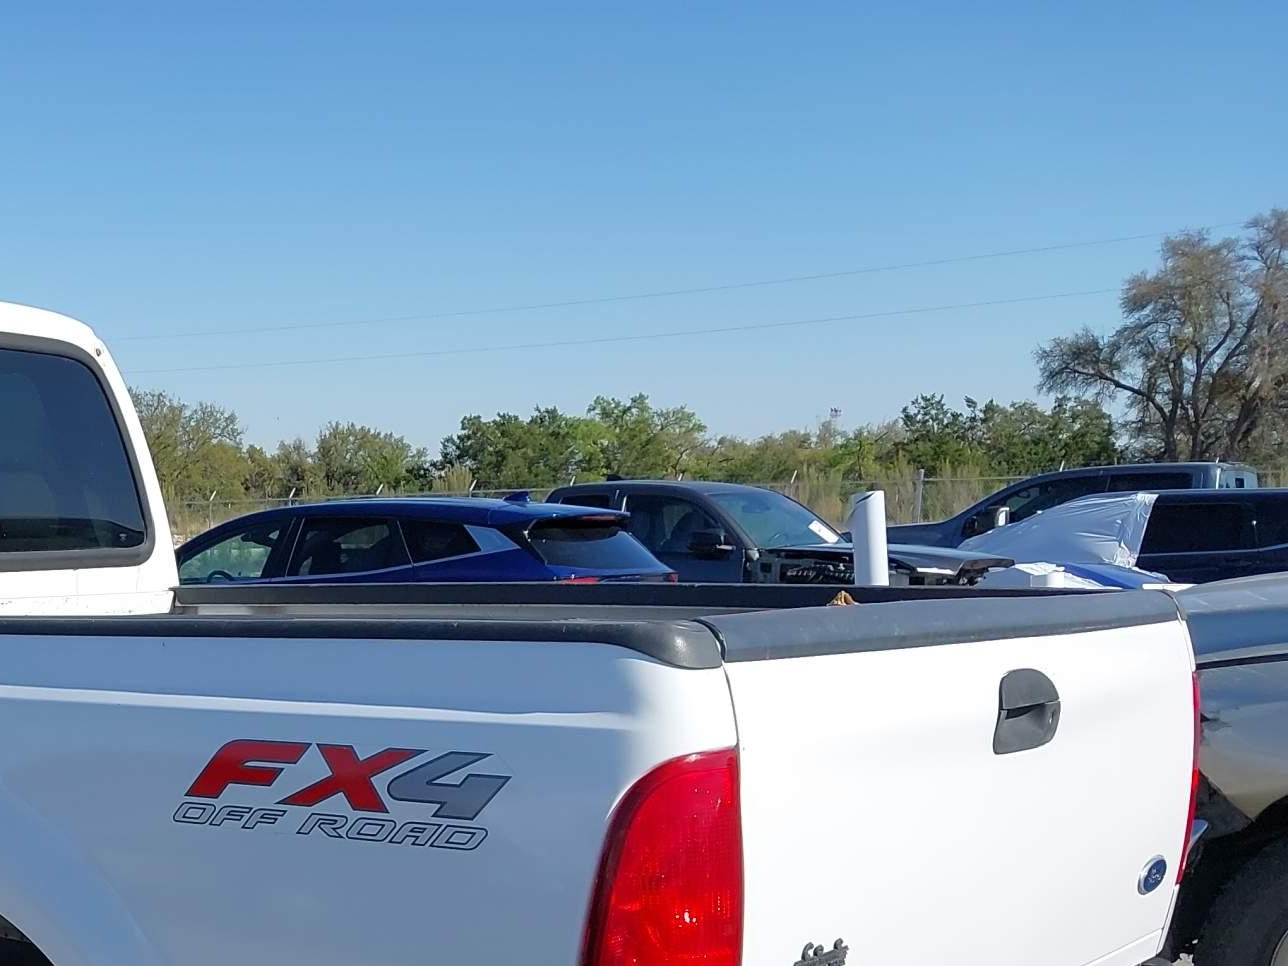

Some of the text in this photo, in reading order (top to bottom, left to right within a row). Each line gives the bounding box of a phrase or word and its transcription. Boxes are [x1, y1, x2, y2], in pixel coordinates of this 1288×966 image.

[184, 739, 512, 820] FX4
[172, 801, 489, 850] OFF ROAD
